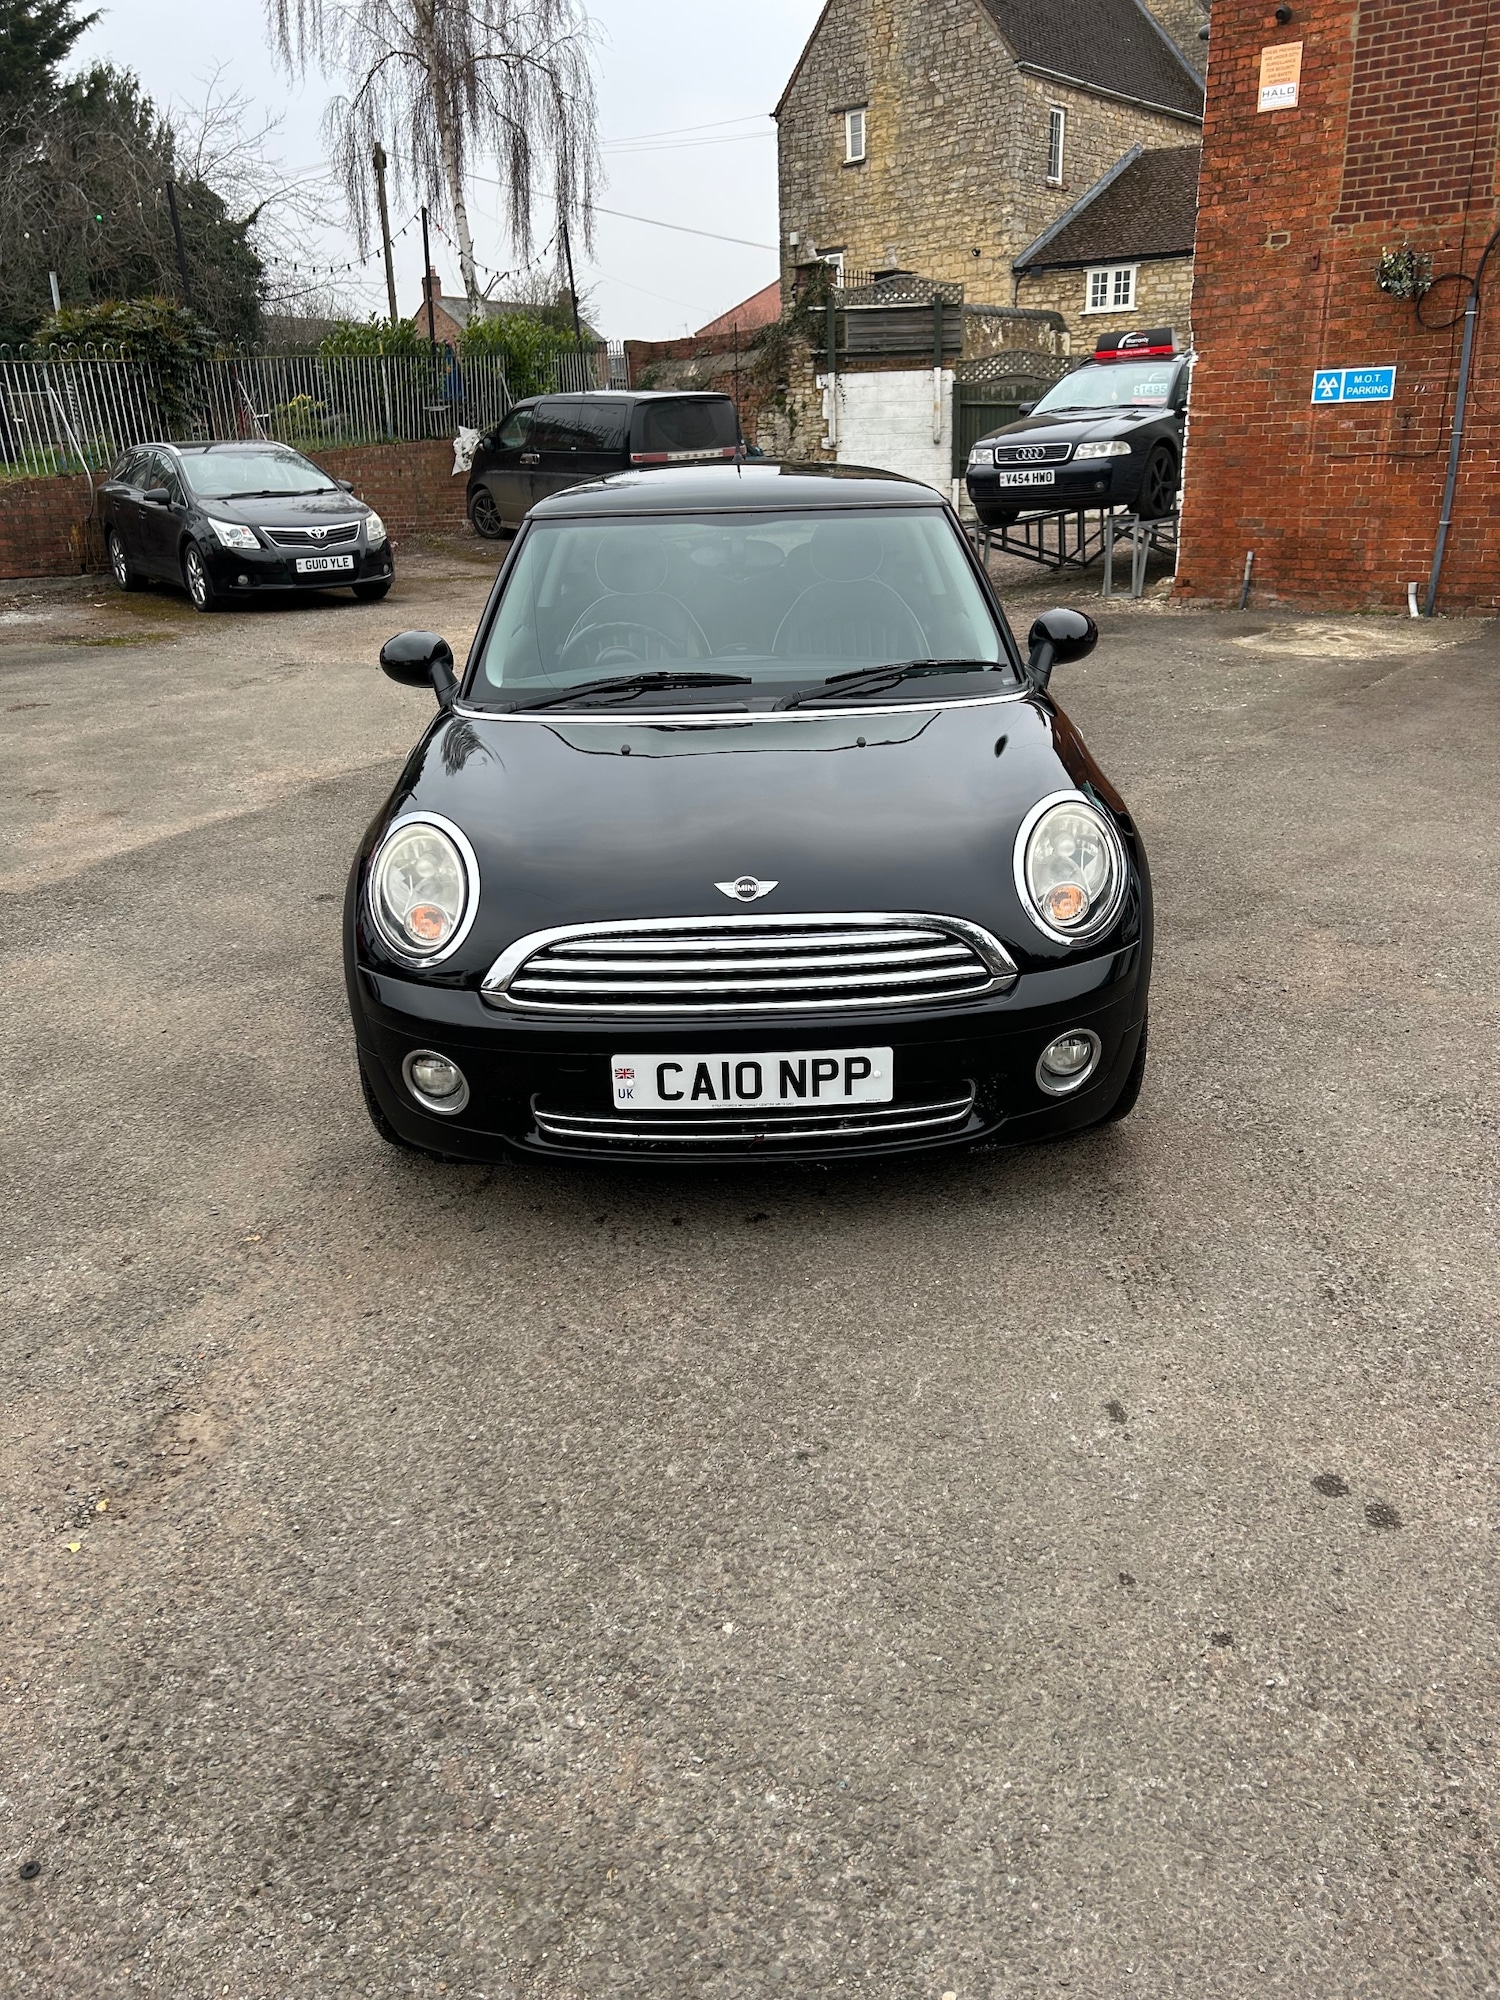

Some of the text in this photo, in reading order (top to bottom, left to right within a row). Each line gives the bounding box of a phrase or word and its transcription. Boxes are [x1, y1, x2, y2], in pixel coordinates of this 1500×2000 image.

[1262, 86, 1295, 98] HALO
[1354, 374, 1383, 384] M.O.T.
[1346, 385, 1388, 395] PARKING
[1006, 473, 1030, 484] V454
[330, 557, 349, 568] YLE
[737, 884, 757, 892] MINI
[656, 1056, 872, 1101] CA10 NPP
[618, 1088, 634, 1099] UK
